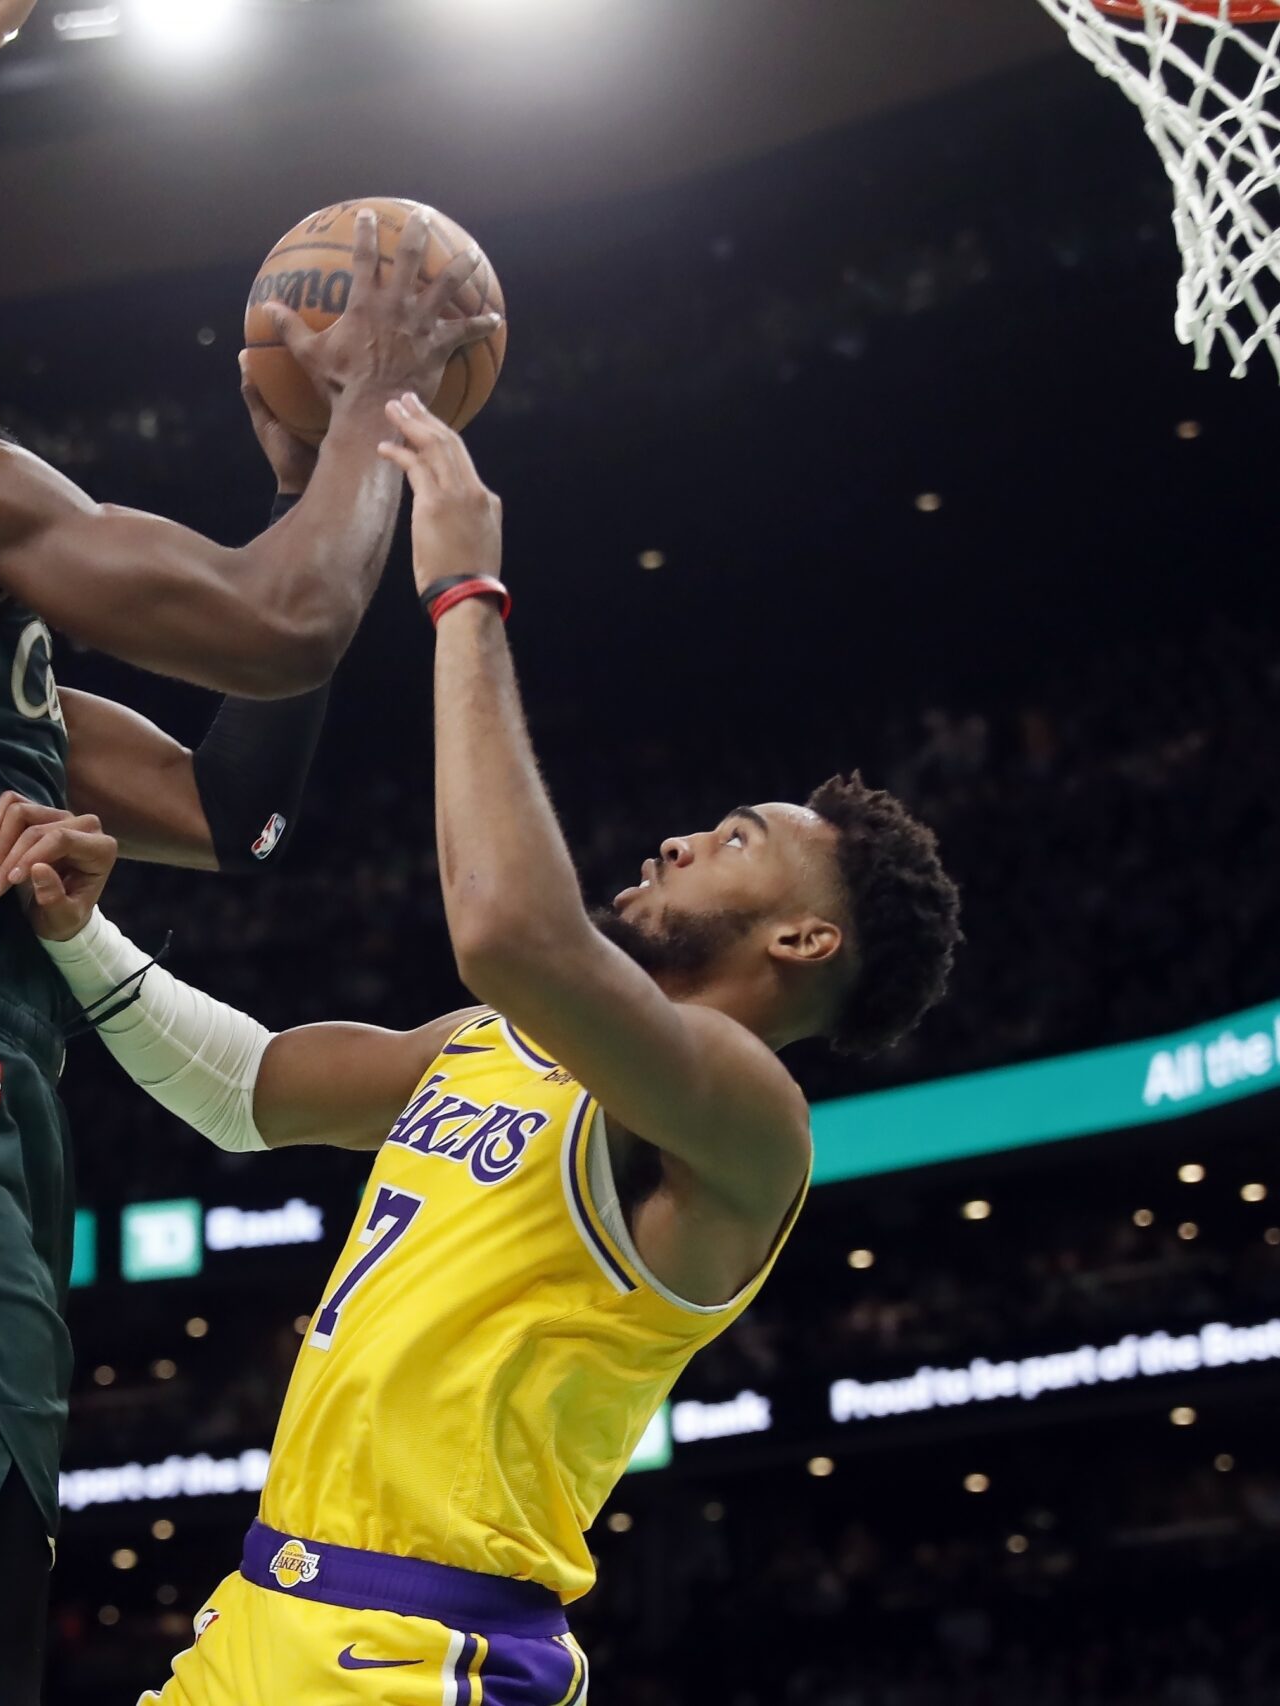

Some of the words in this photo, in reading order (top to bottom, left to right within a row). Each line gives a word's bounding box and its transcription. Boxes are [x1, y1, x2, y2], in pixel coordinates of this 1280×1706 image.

[1141, 1042, 1205, 1107] All
[1205, 1029, 1273, 1089] the
[205, 1198, 324, 1251] Bank
[308, 1182, 426, 1352] 7
[829, 1366, 934, 1423] Proud
[933, 1367, 970, 1407] to
[969, 1357, 1020, 1401] be
[1019, 1345, 1099, 1400] part
[1097, 1333, 1139, 1382] of
[1138, 1330, 1201, 1377] the
[672, 1388, 772, 1443] Bank
[269, 1549, 317, 1581] LAKERS
